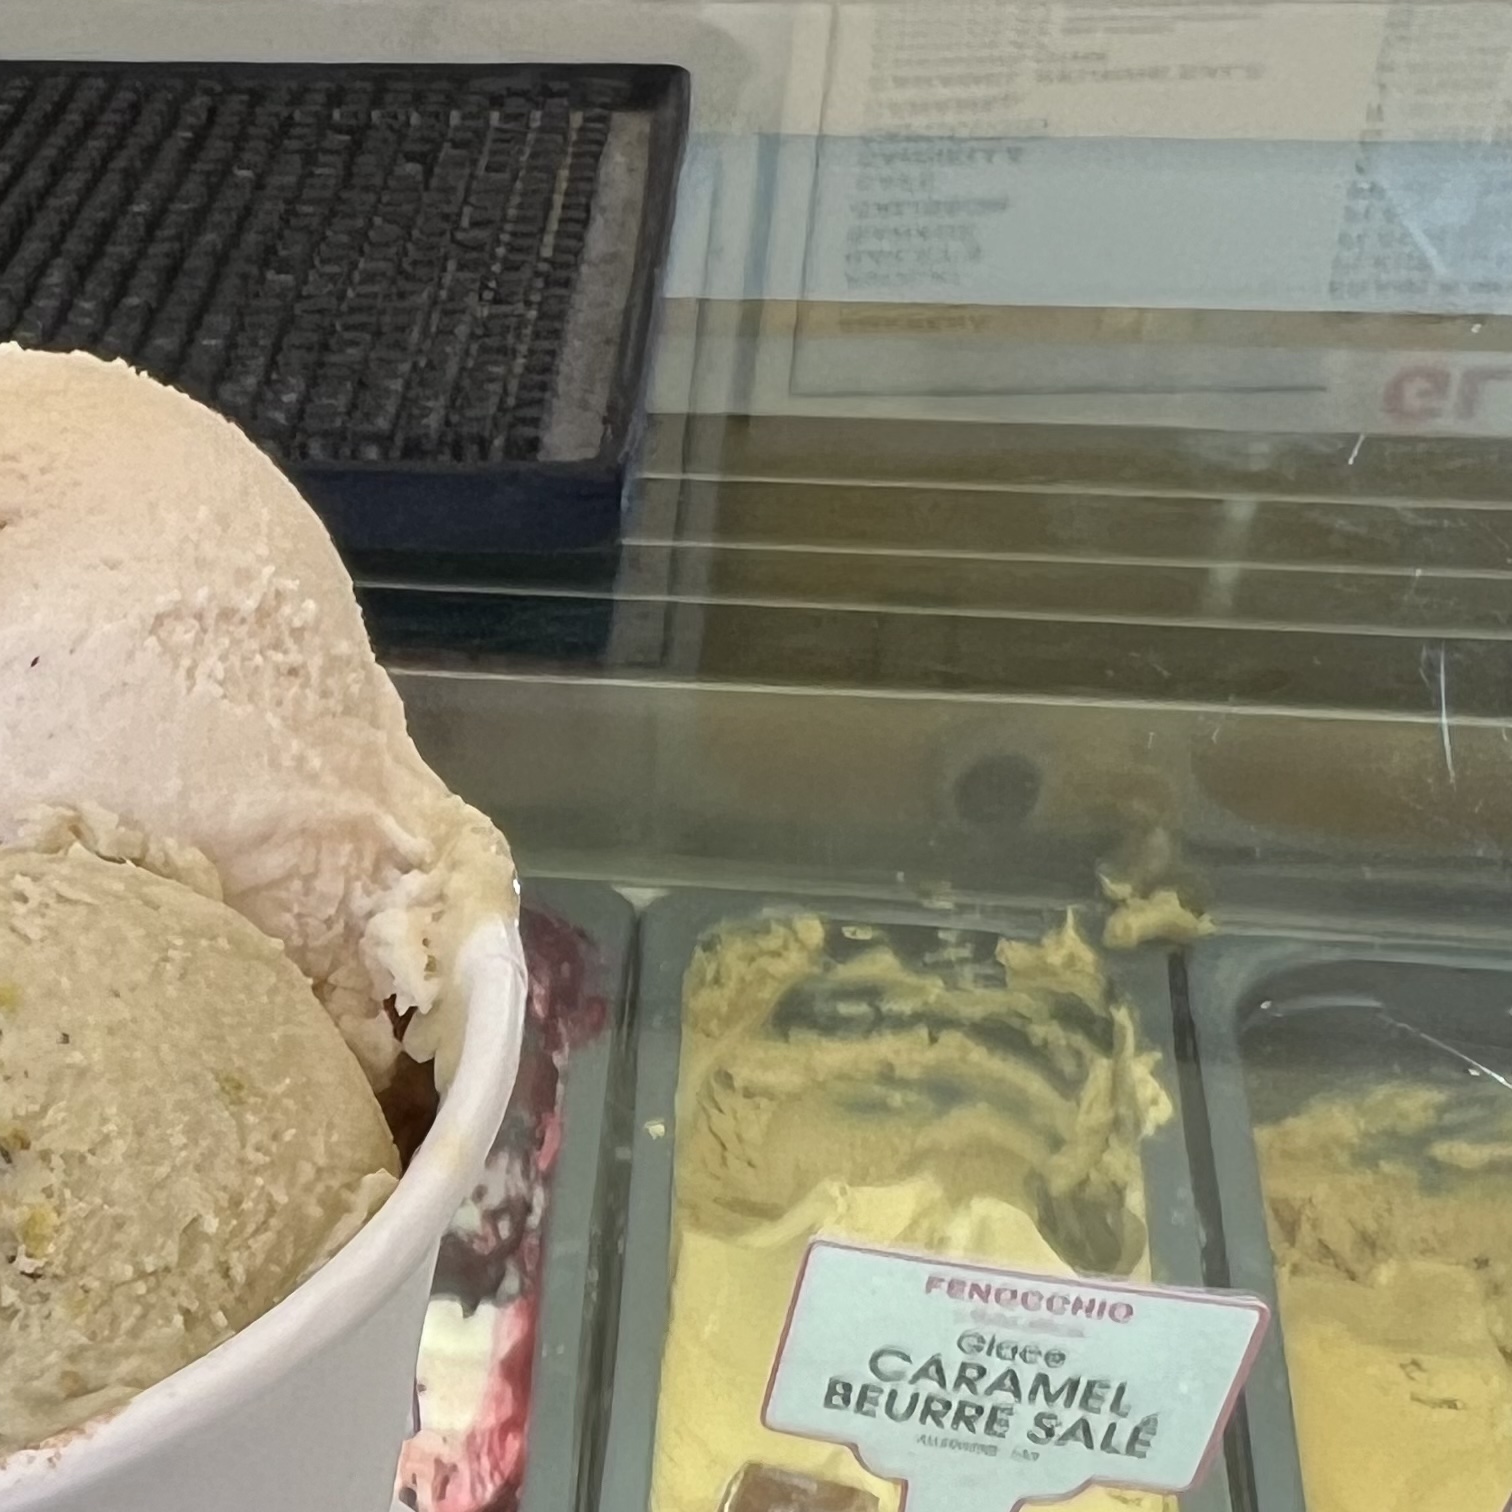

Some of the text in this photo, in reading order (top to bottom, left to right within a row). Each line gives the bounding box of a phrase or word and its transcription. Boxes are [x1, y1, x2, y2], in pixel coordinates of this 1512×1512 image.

[925, 1276, 1135, 1323] FENOCCHIO
[823, 1376, 1015, 1438] BEURRE
[1026, 1411, 1160, 1459] SALÉ
[868, 1345, 1131, 1418] CARAMEL
